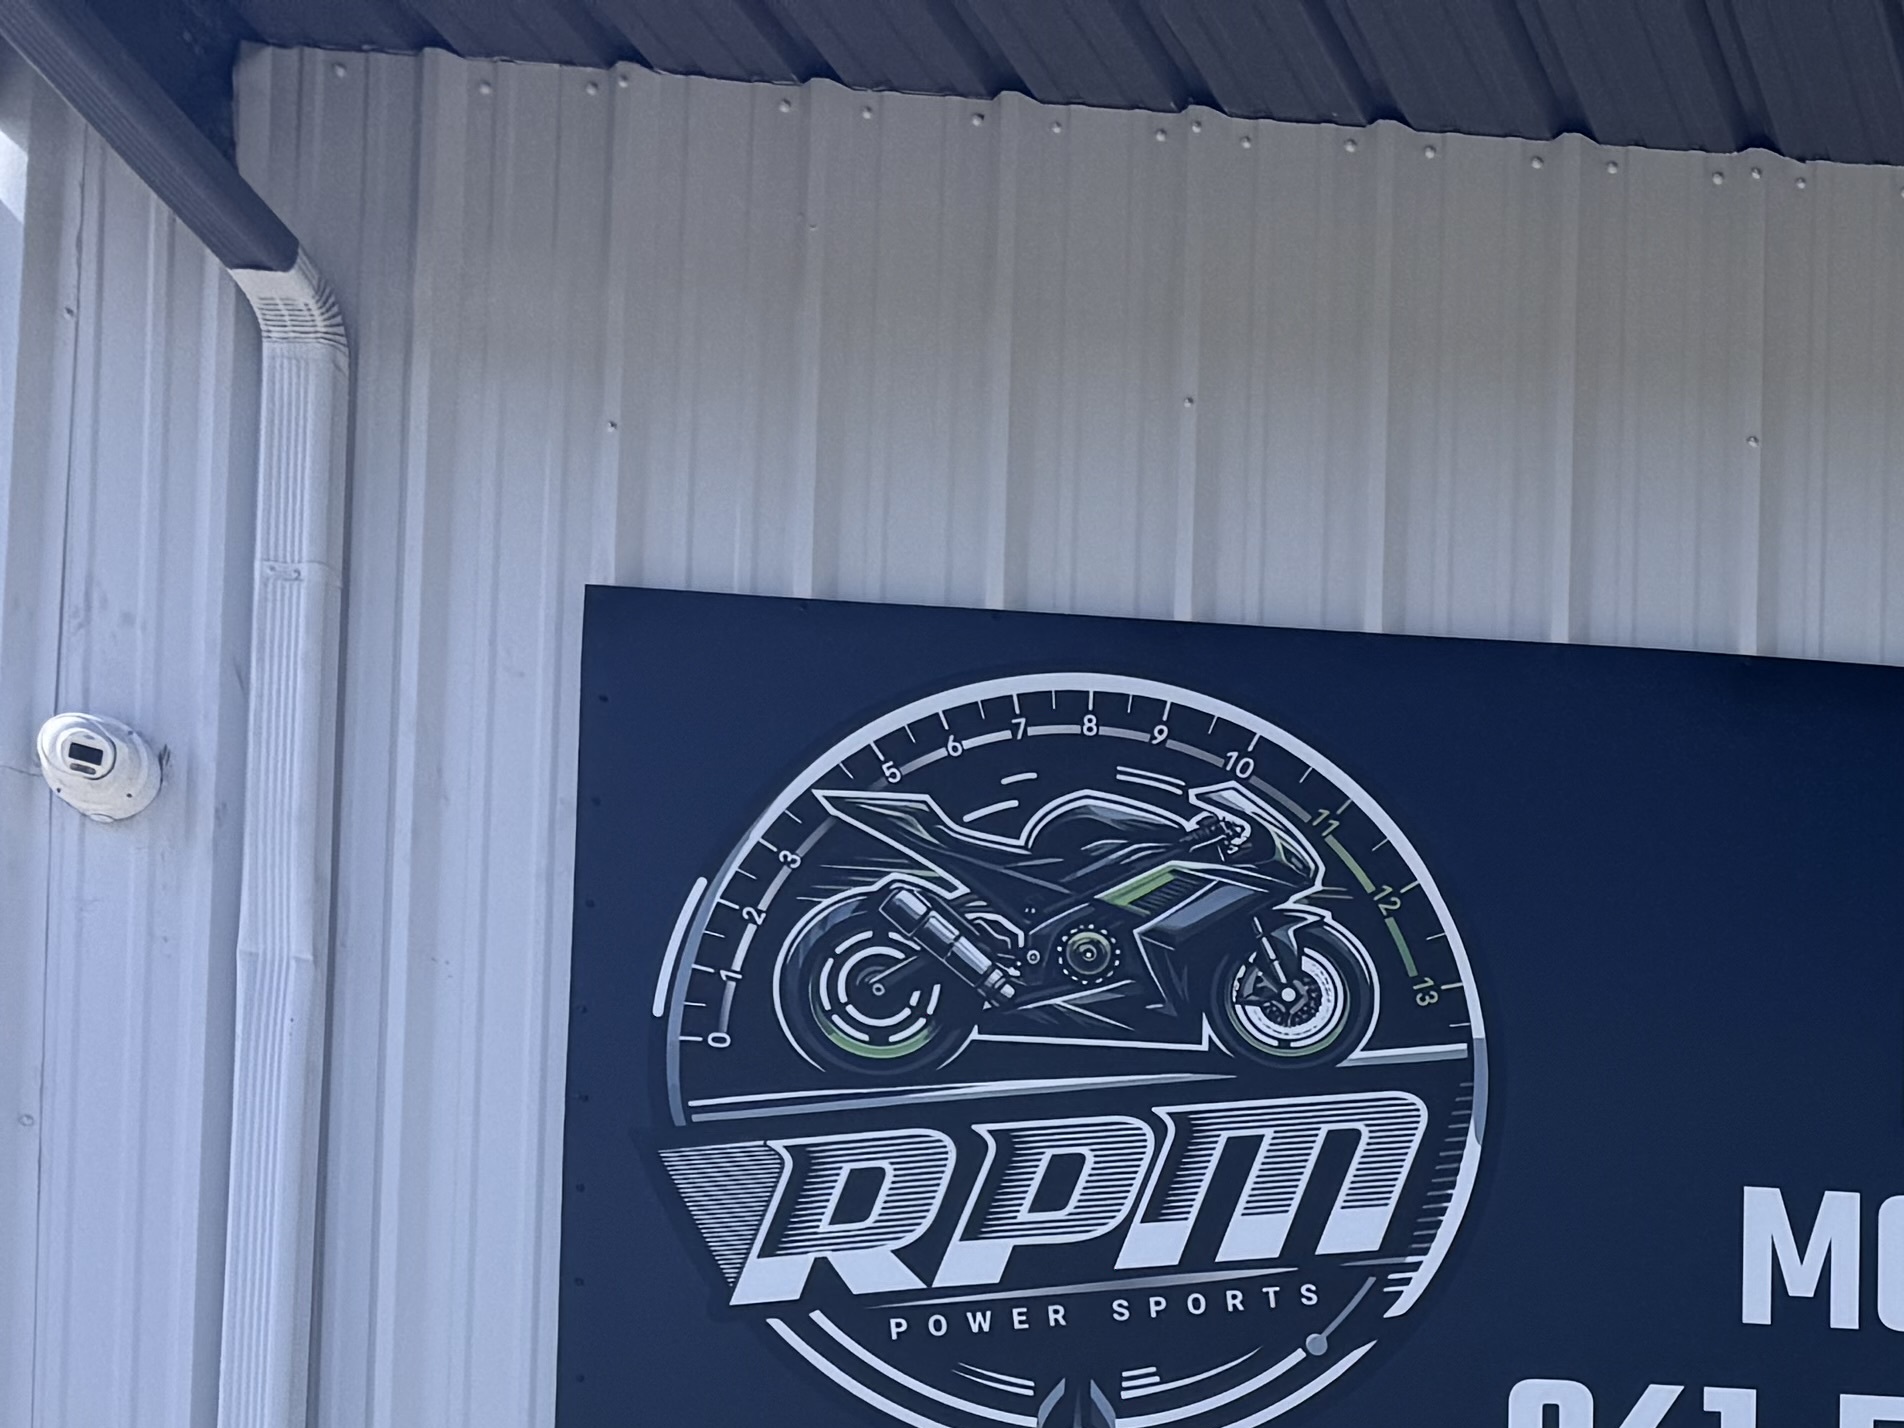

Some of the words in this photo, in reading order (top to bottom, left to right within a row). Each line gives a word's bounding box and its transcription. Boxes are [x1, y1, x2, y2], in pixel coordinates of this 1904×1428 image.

[882, 761, 902, 784] 5
[946, 736, 964, 759] 6
[1010, 718, 1027, 741] 7
[1081, 713, 1099, 737] 8
[1151, 723, 1169, 747] 9
[1222, 750, 1256, 780] 10
[730, 1091, 1428, 1306] RPM
[890, 1304, 1068, 1341] POWER
[1112, 1283, 1319, 1321] SPORTS
